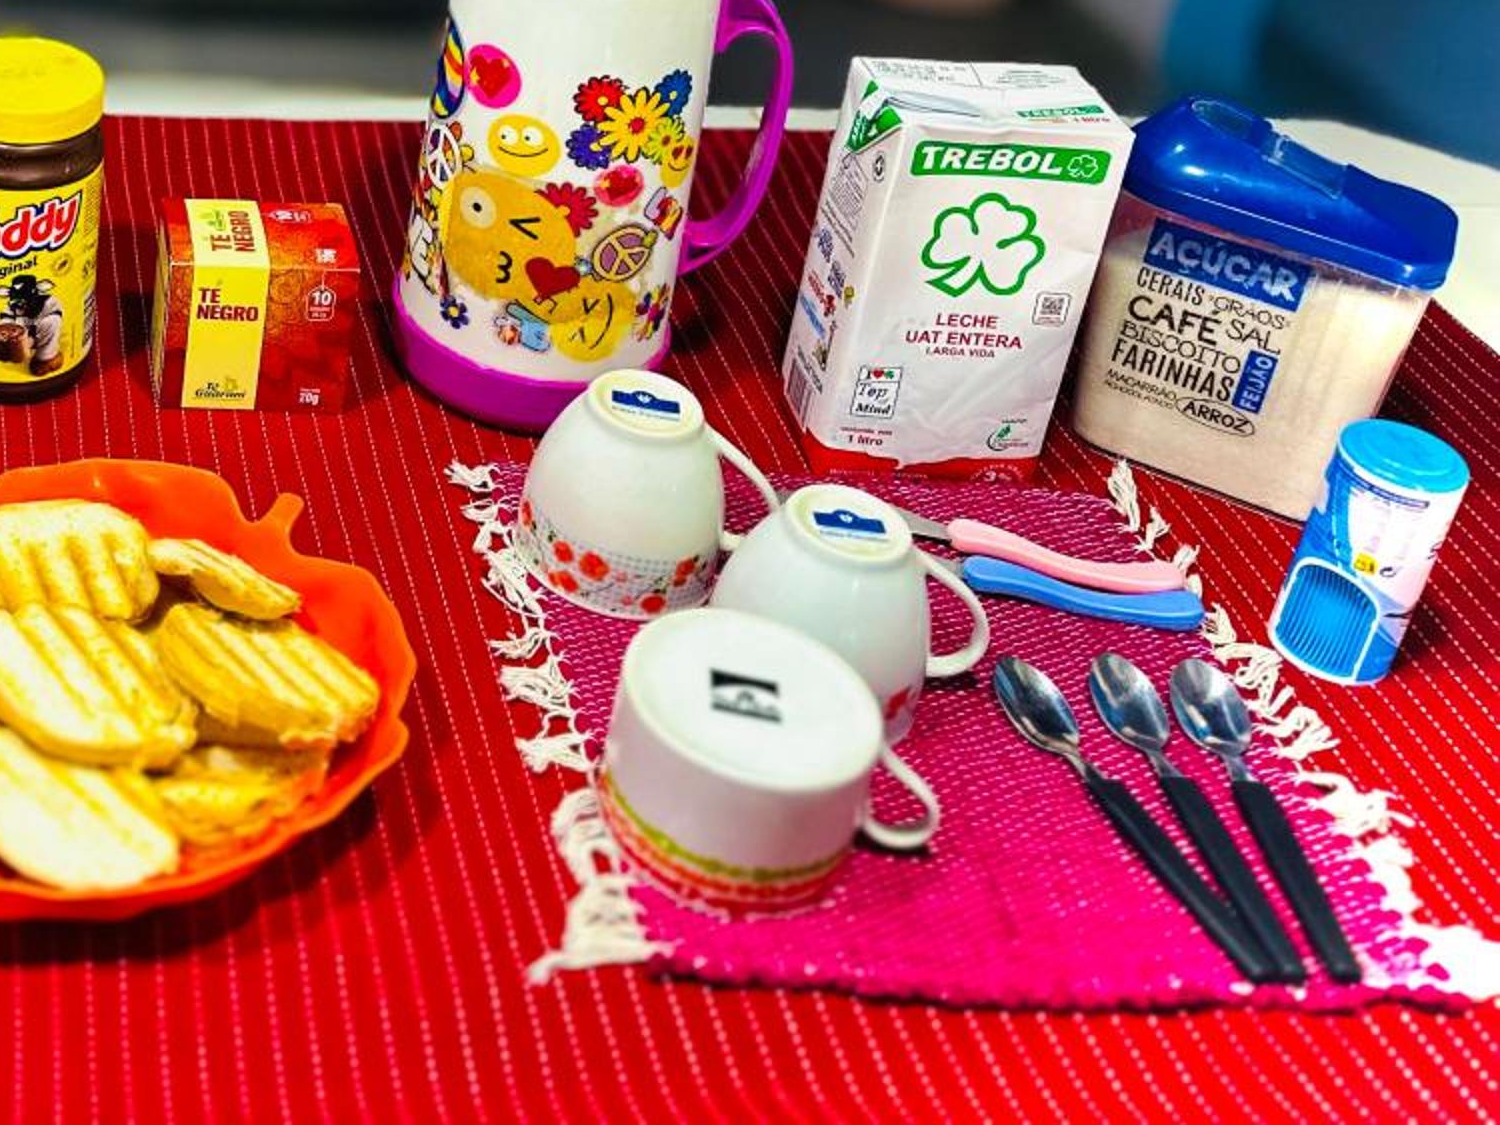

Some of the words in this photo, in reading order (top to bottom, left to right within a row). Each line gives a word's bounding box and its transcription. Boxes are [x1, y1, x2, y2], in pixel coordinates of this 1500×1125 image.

[920, 146, 1063, 175] TREBOL
[228, 210, 255, 252] NEGRO
[1151, 231, 1298, 302] AÇÚCAR
[312, 291, 332, 305] 10
[196, 304, 258, 321] NEGRO
[935, 313, 999, 329] LECHE
[1128, 295, 1221, 346] CAFÉ
[905, 330, 942, 343] UAT
[946, 332, 1022, 349] ENTERA
[1120, 320, 1241, 374] BISCOITO
[926, 346, 964, 356] LARGA
[969, 348, 995, 358] VIDA
[1112, 338, 1234, 402] FARINHAS
[859, 382, 888, 401] Top
[855, 402, 891, 414] Mind
[1183, 402, 1250, 433] ARROZ
[858, 435, 883, 446] litro
